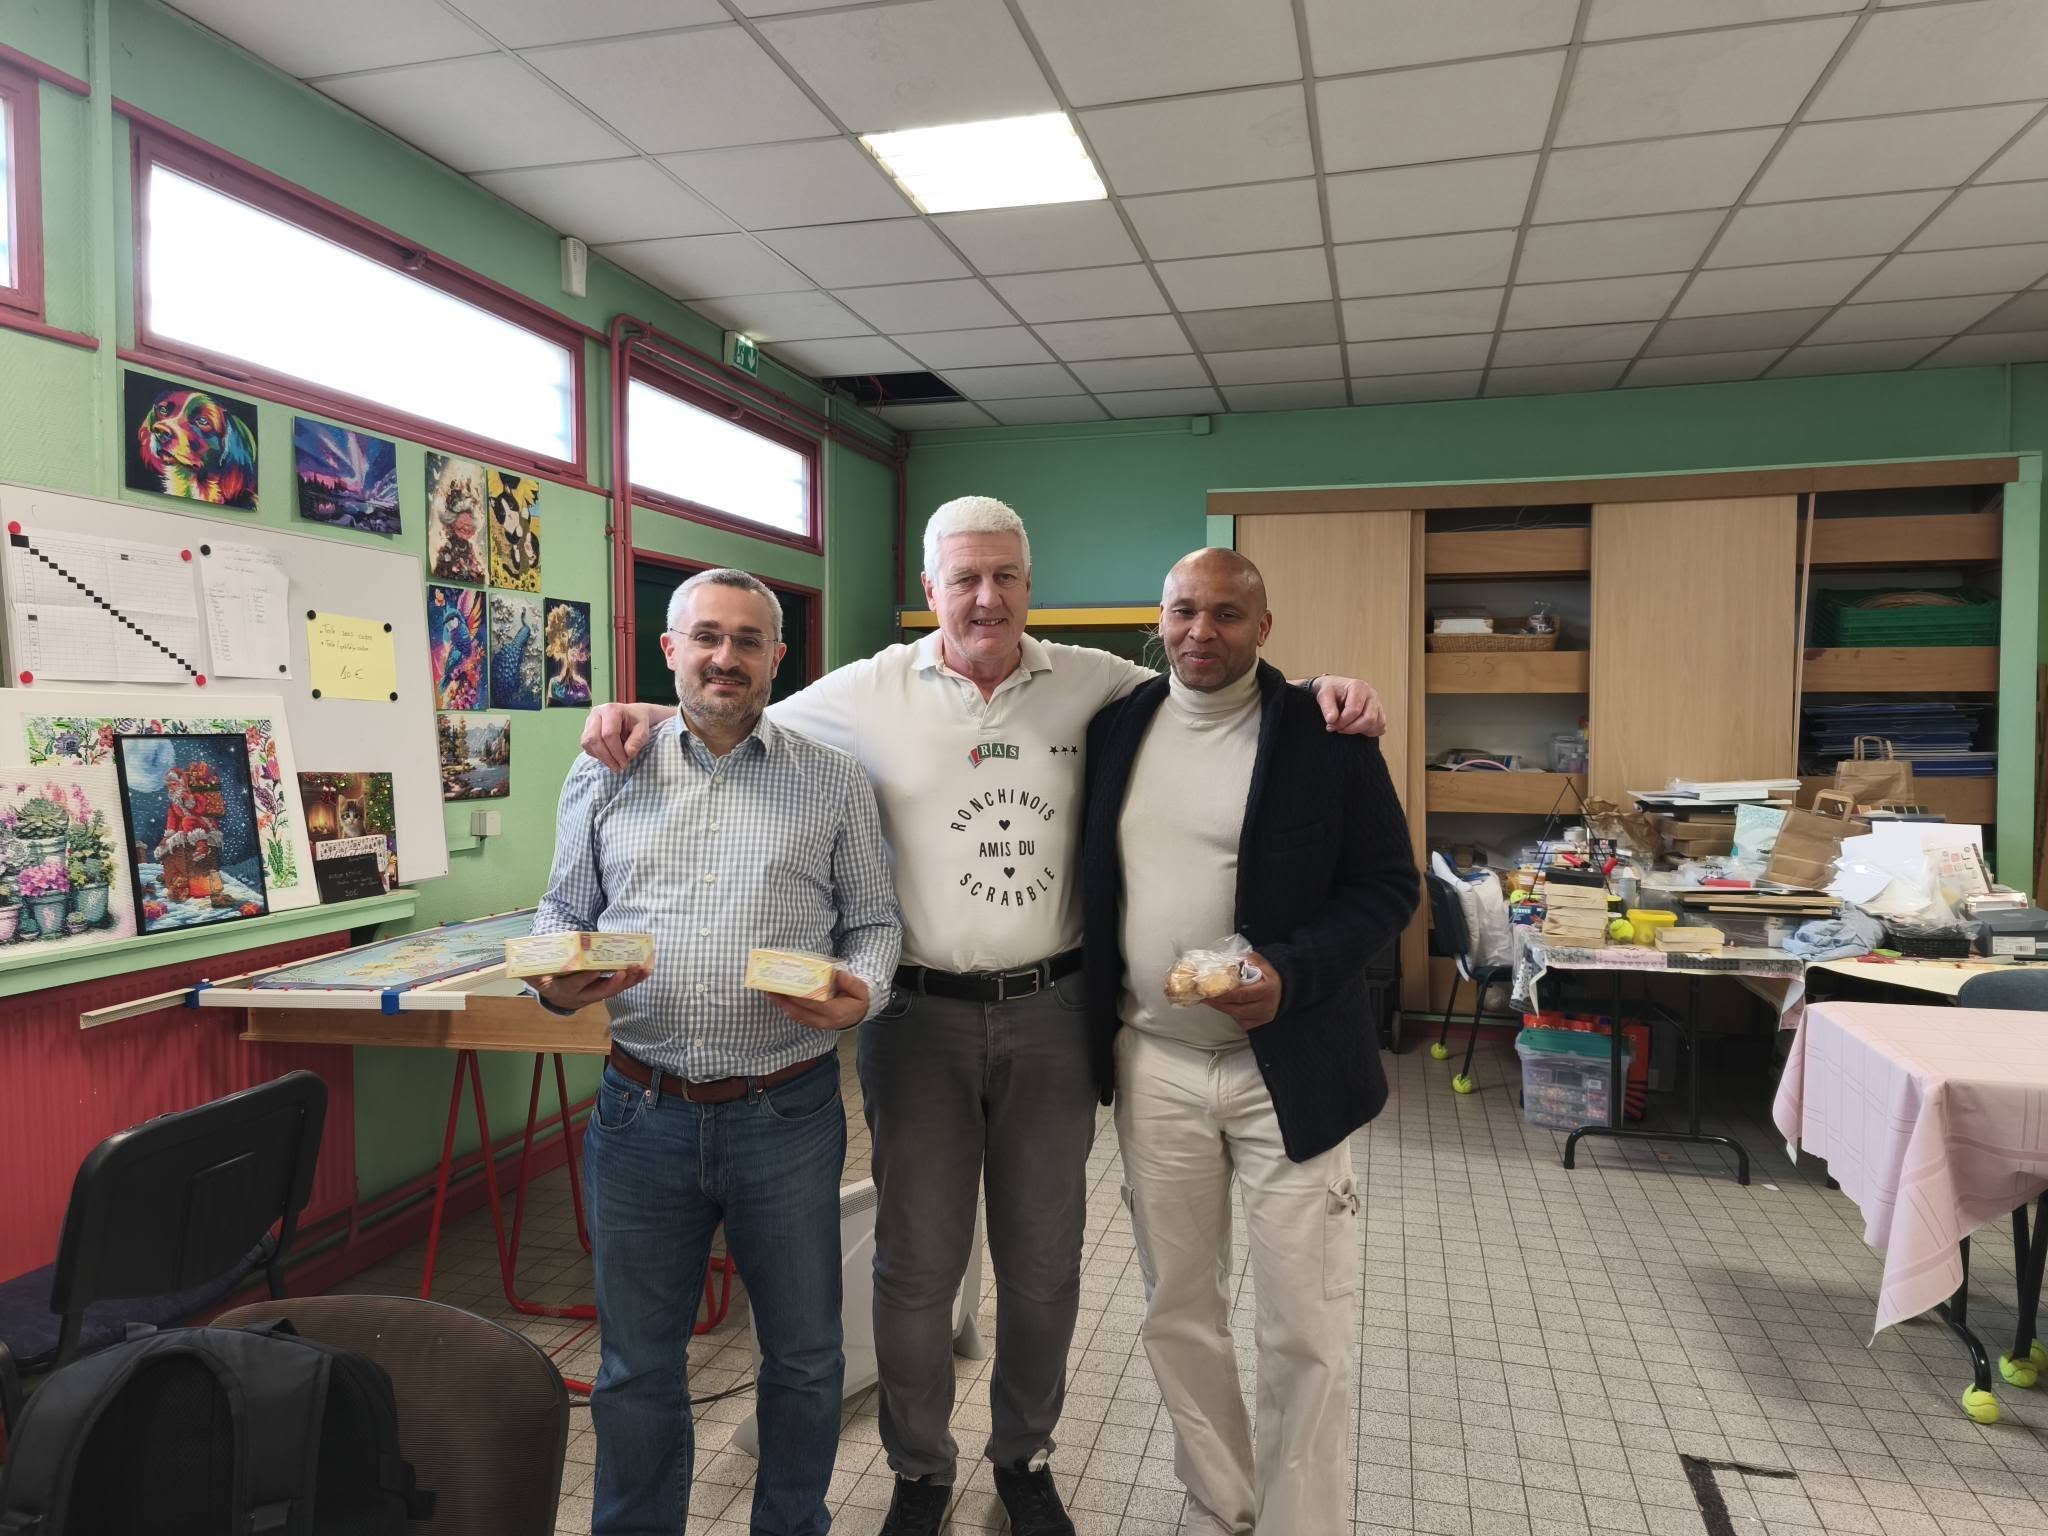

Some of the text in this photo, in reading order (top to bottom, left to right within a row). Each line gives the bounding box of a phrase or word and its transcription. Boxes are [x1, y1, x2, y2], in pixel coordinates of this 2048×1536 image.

[979, 743, 1018, 759] RAS
[950, 788, 1055, 832] RONCHINOIS
[979, 840, 1035, 858] AMIS DU
[959, 867, 1055, 906] SCRABBLE
